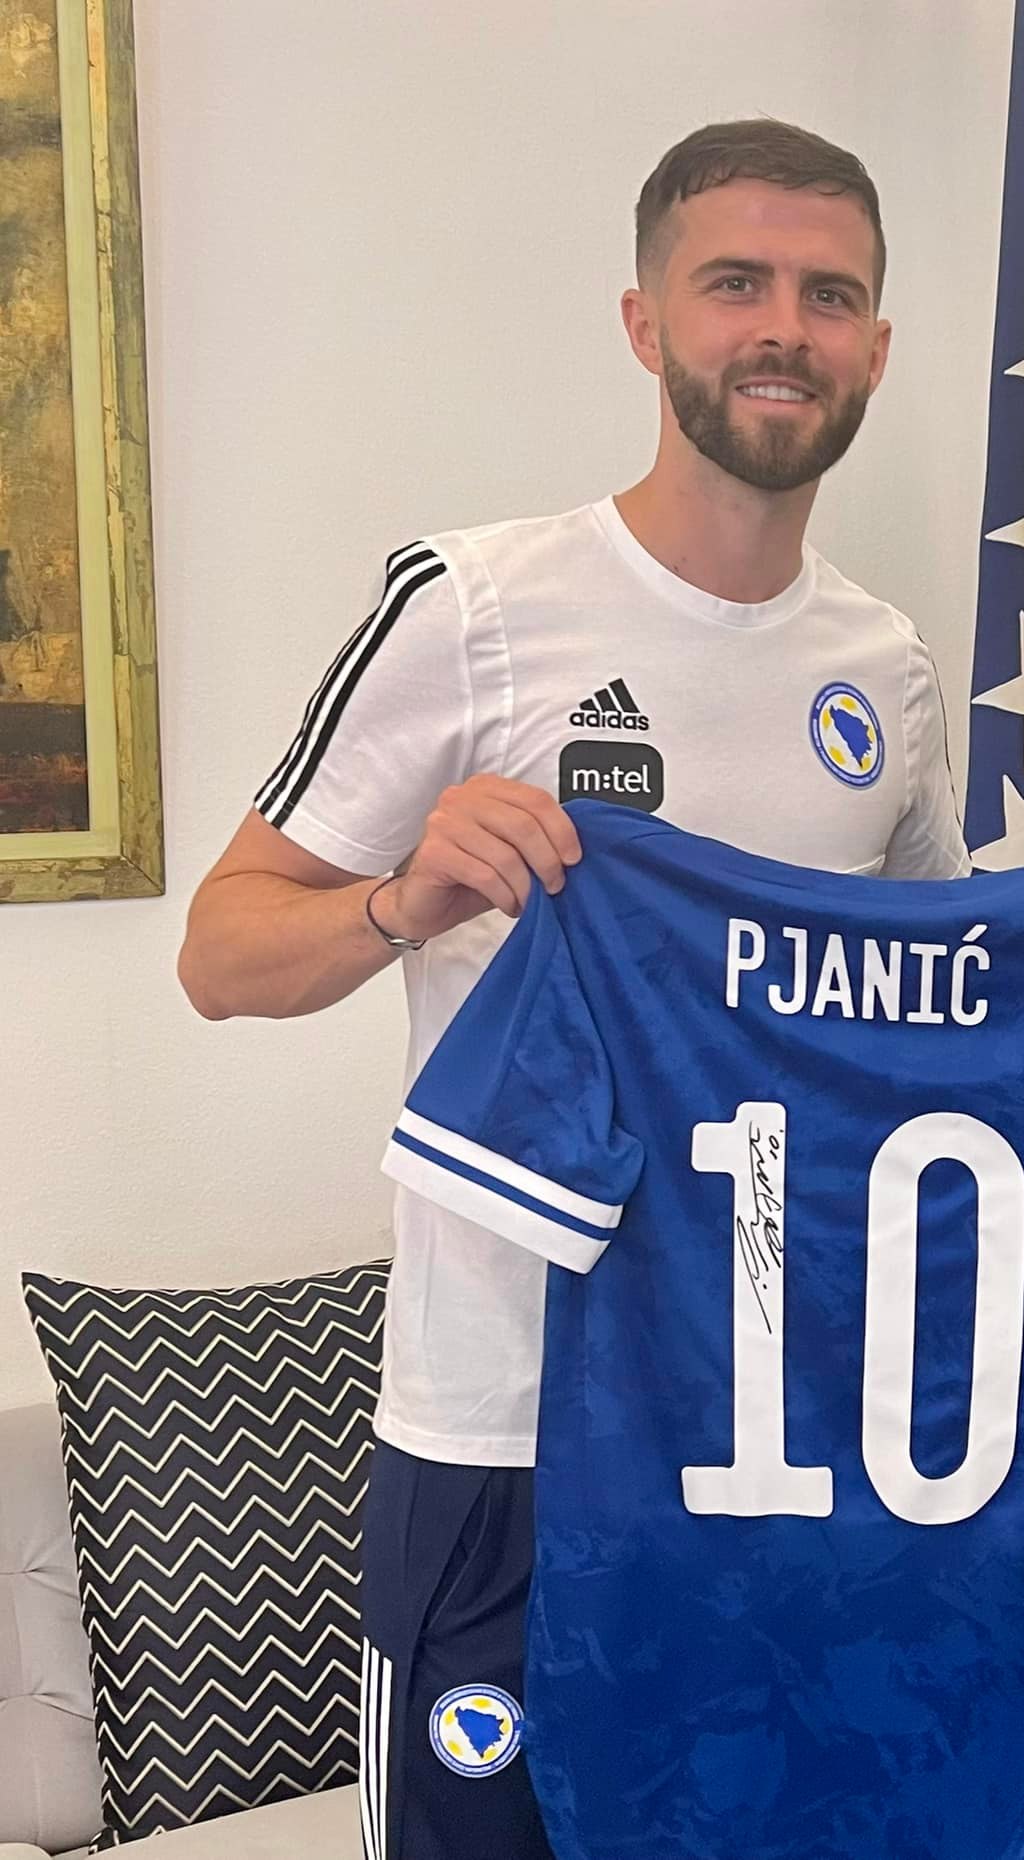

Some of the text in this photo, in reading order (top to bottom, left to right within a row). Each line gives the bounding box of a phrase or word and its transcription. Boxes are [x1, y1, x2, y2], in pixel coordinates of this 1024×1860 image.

[569, 709, 650, 731] adidas
[572, 763, 652, 794] m:tel
[725, 917, 991, 1026] PJANIĆ
